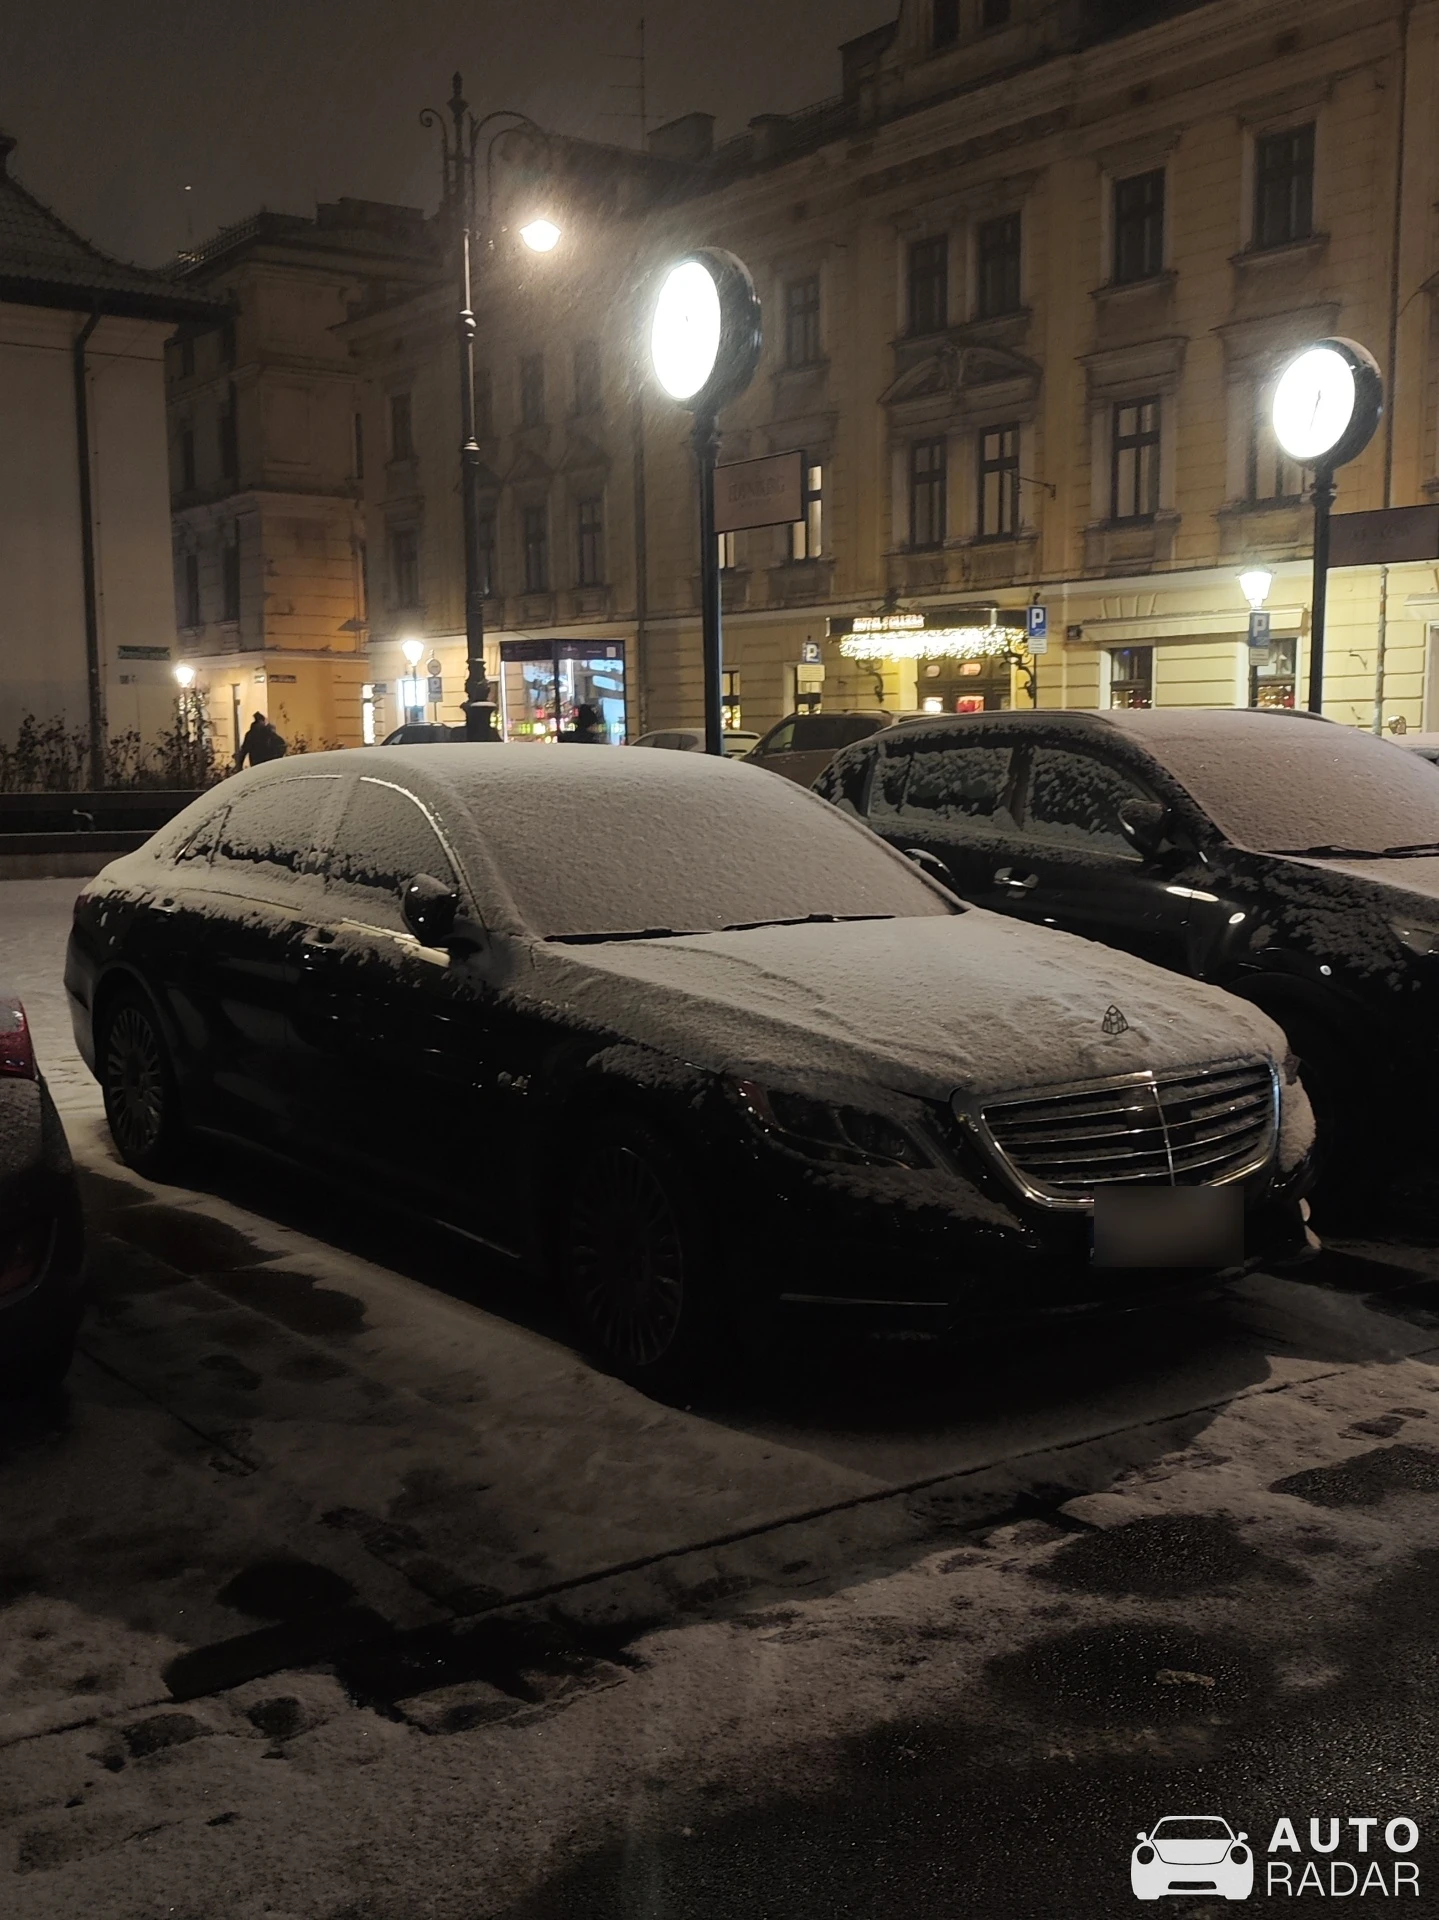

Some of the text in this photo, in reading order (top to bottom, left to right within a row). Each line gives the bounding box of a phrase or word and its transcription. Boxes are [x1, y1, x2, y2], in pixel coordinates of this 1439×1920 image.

[1031, 608, 1044, 629] P
[1253, 615, 1267, 637] P
[806, 644, 818, 662] P
